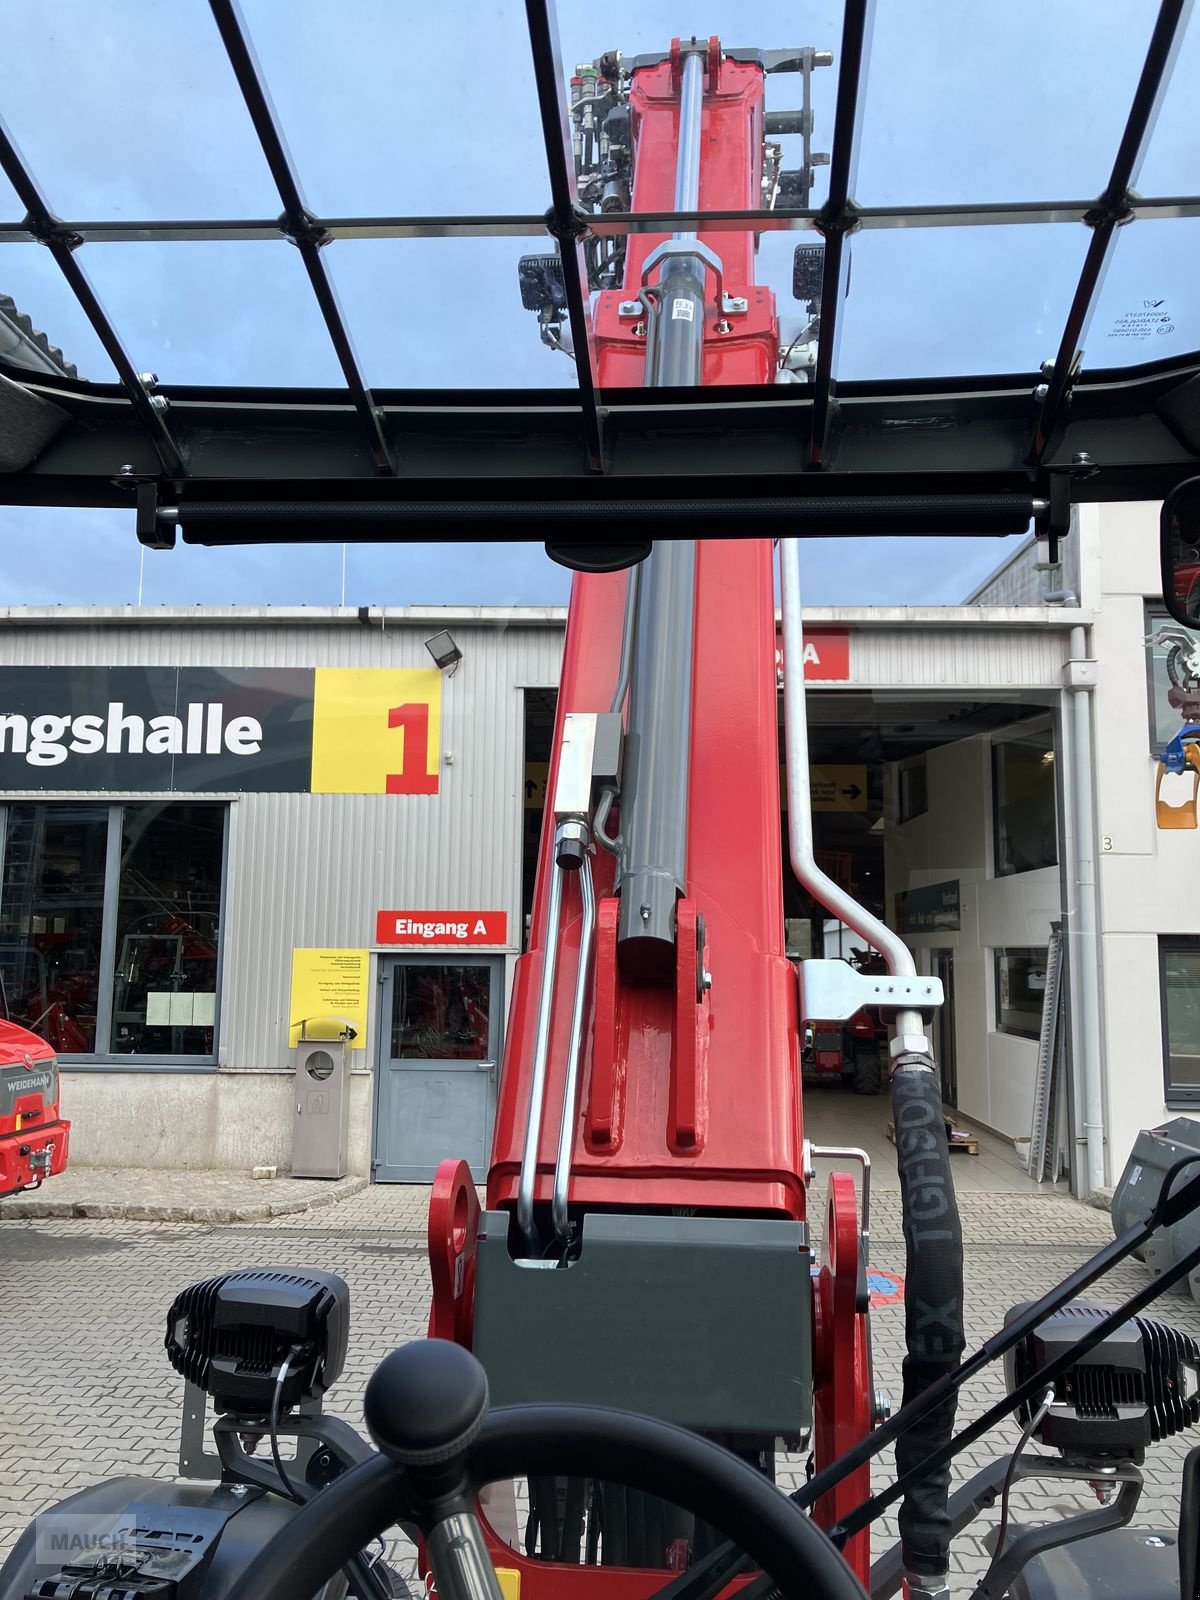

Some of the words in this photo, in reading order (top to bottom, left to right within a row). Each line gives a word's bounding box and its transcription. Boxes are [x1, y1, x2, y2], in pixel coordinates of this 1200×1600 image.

[803, 643, 821, 665] A
[385, 703, 439, 794] 1
[1103, 836, 1113, 851] 3
[395, 918, 469, 938] Eingang
[472, 919, 488, 935] A
[7, 1074, 50, 1092] WEIDEMANN
